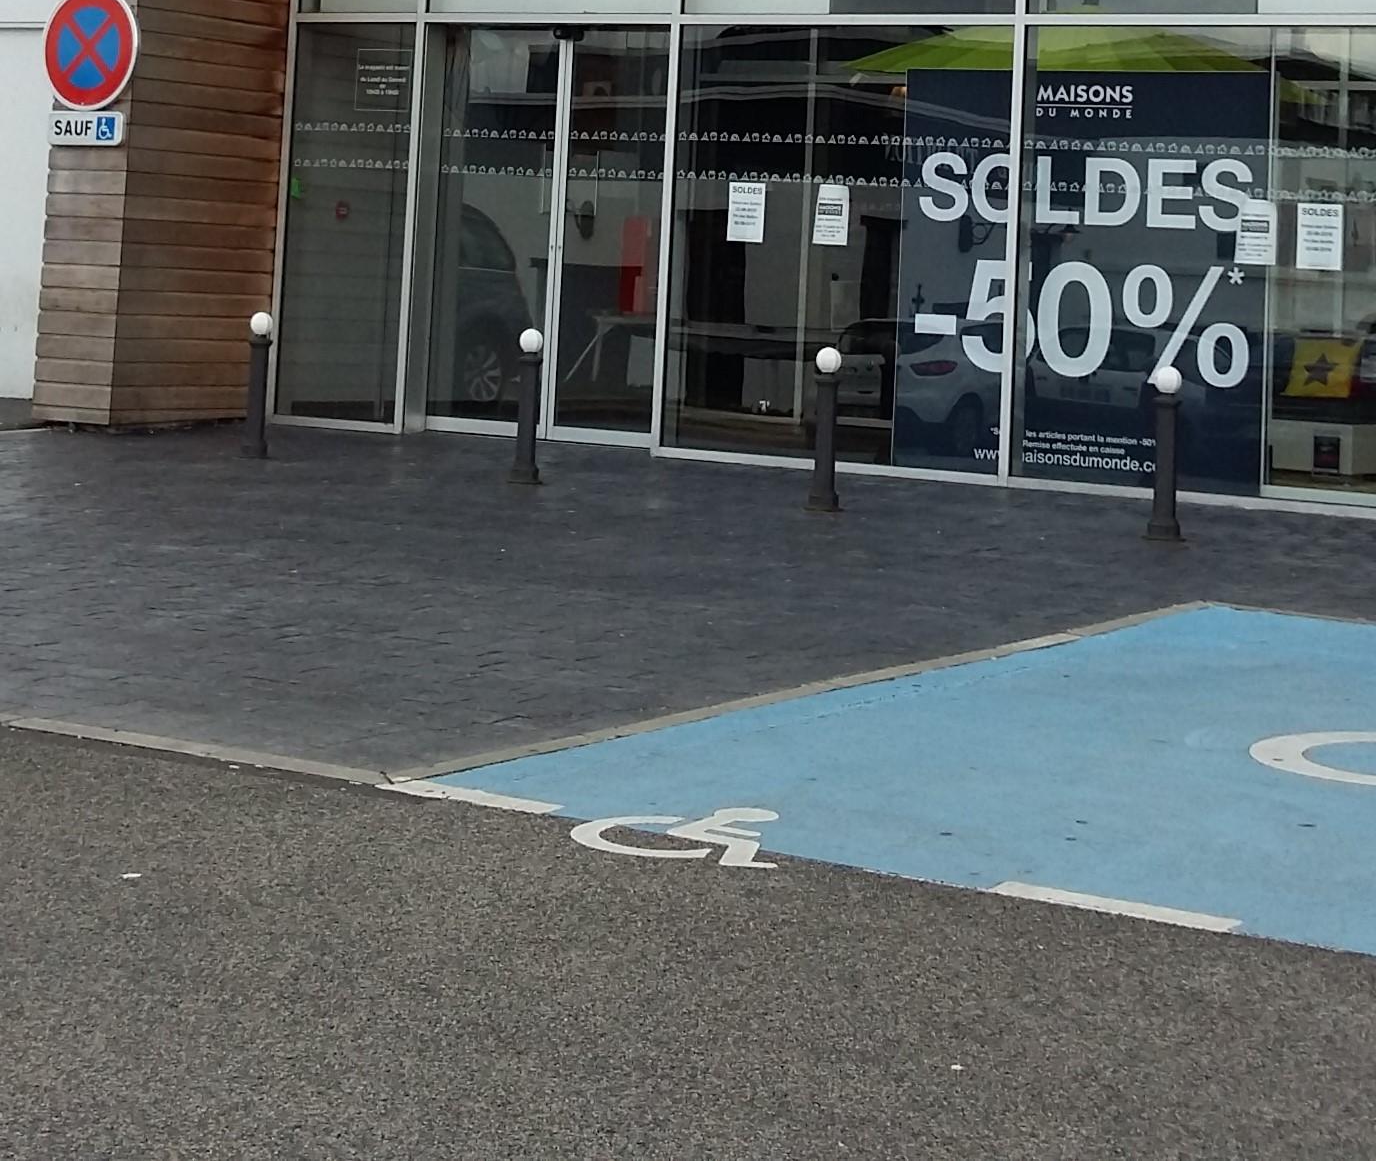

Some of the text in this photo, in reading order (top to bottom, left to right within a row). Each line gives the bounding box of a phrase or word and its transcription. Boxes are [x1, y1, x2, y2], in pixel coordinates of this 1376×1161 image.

[1036, 84, 1133, 103] MAISONS
[1035, 107, 1133, 119] DU MONDE
[54, 119, 94, 137] SAUF
[732, 186, 762, 195] SOLDES
[918, 151, 1254, 232] SOLDES
[1301, 207, 1340, 217] SOLDES
[1067, 433, 1096, 442] portant
